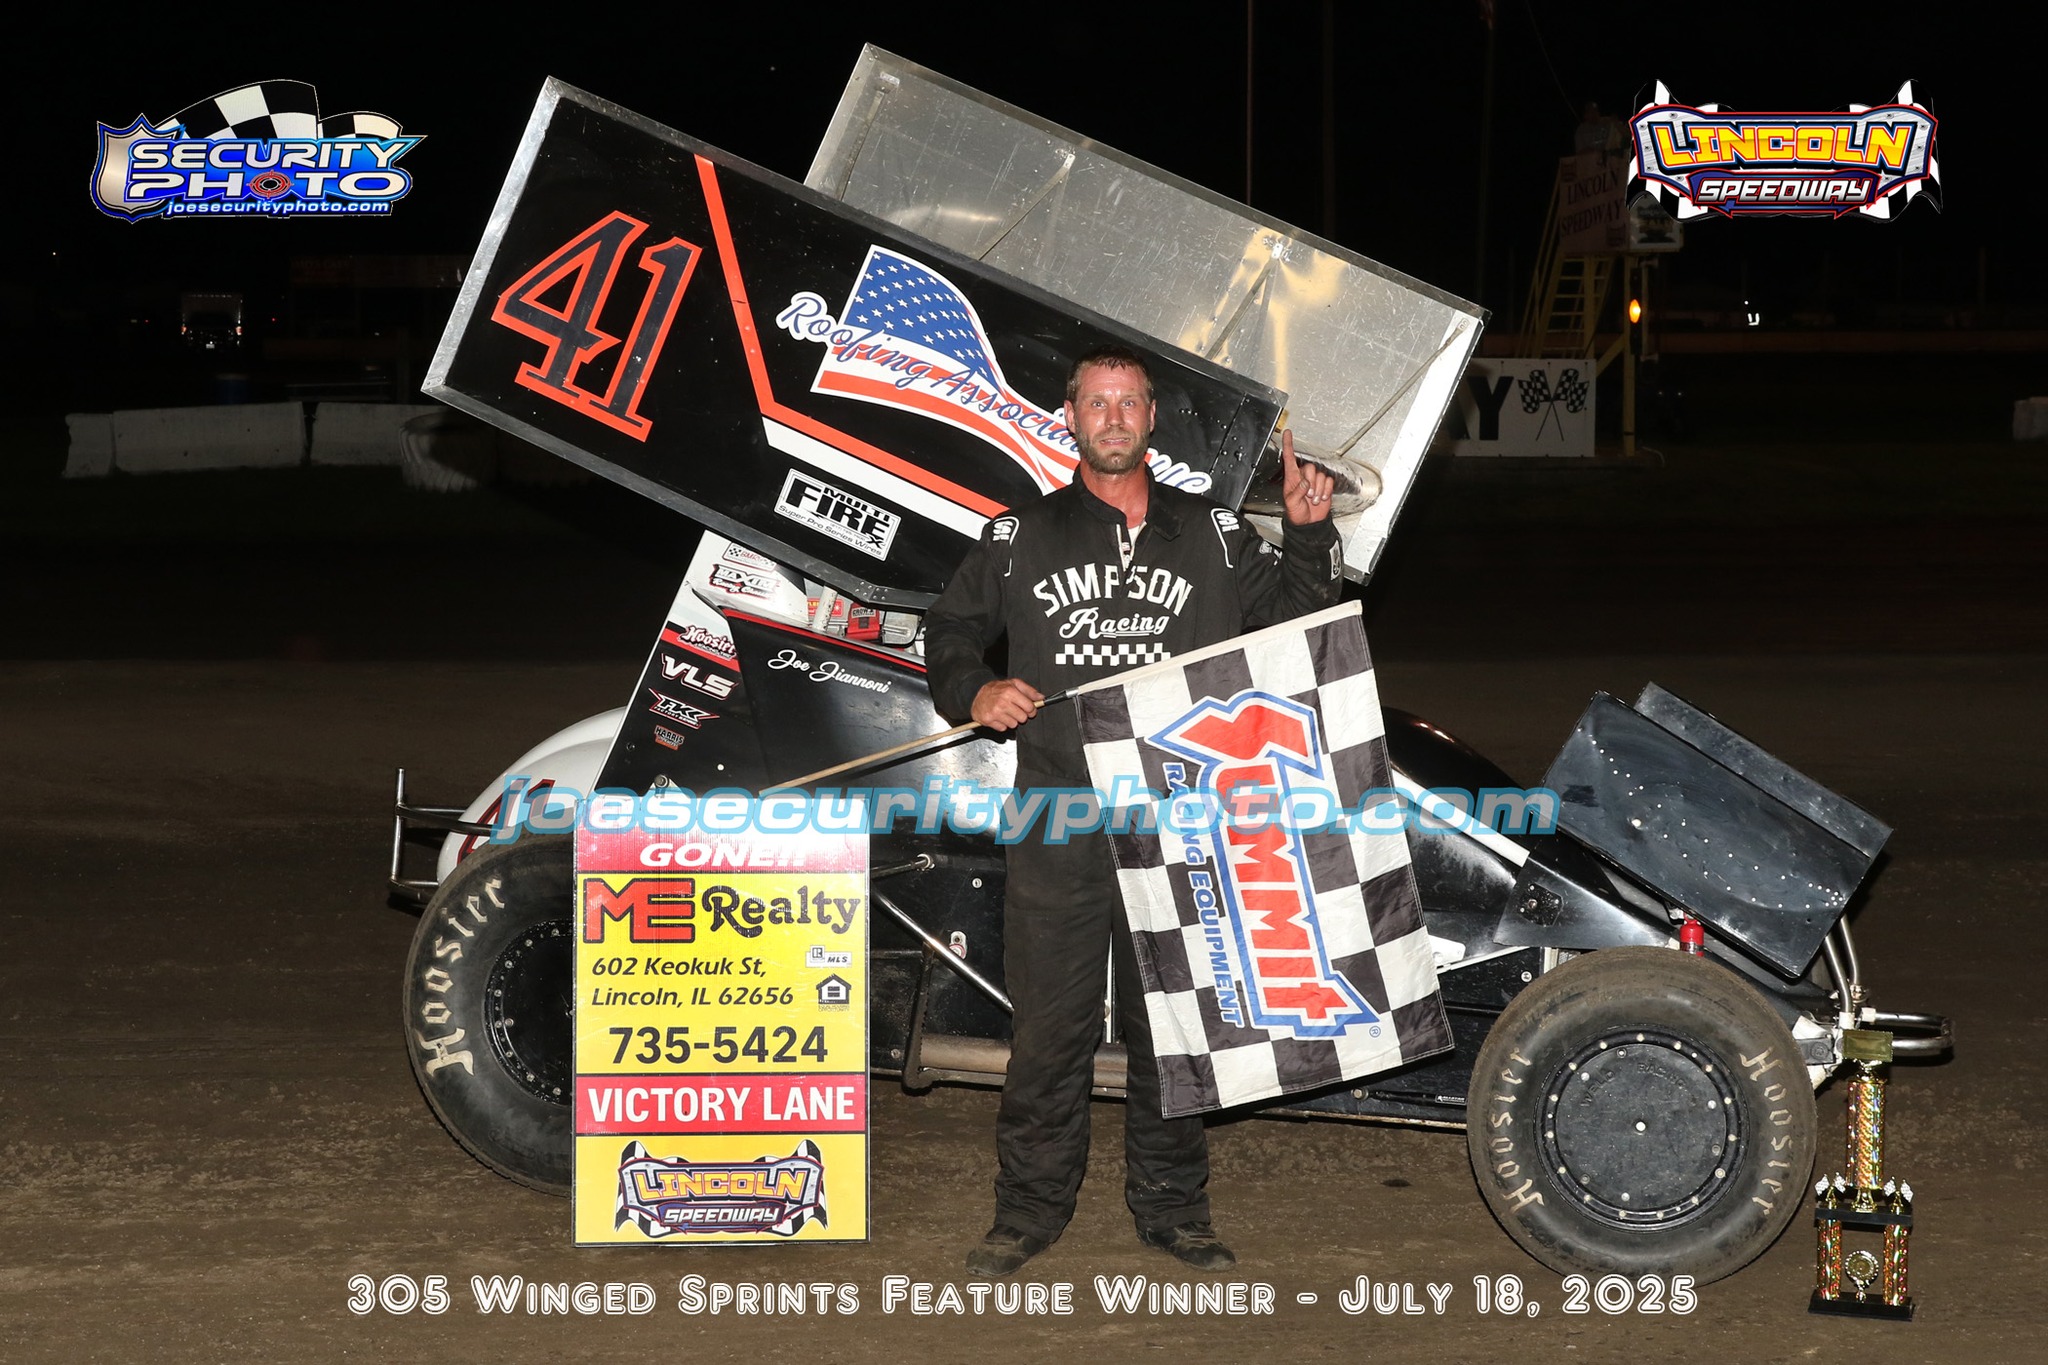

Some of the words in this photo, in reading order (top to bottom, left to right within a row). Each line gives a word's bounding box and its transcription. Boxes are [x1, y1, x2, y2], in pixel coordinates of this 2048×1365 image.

[1567, 168, 1621, 205] LINCOLN
[1560, 199, 1626, 237] SPEEDWAY
[491, 210, 703, 443] 41
[782, 296, 934, 389] Roofing
[785, 477, 890, 541] FIRE
[824, 486, 890, 522] MULTI
[779, 505, 806, 521] Super
[807, 516, 824, 529] Pro
[825, 525, 853, 543] Series
[854, 539, 882, 556] Wires
[714, 565, 775, 592] MAXIM
[1033, 562, 1194, 617] SIMPSON
[681, 626, 736, 654] Hoosier
[1058, 607, 1170, 639] Racing
[664, 655, 735, 698] VLS
[768, 649, 811, 671] Joe
[1178, 704, 1349, 1020] SUMMIT
[583, 878, 695, 943] ME
[701, 885, 862, 938] Realty
[1164, 763, 1206, 864] RACING
[1190, 873, 1243, 1027] EQUIPMENT
[415, 877, 505, 1078] Hoosier
[592, 957, 638, 976] 602
[644, 956, 733, 976] Keokuk
[739, 956, 767, 978] St,
[827, 955, 849, 964] MLS
[592, 987, 683, 1008] Lincoln,
[691, 987, 712, 1006] IL
[719, 986, 794, 1006] 62656
[609, 1026, 828, 1064] 735-5424
[588, 1086, 751, 1123] VICTORY
[763, 1086, 855, 1122] LANE
[1490, 1046, 1545, 1214] Hoosier
[1739, 1046, 1794, 1215] Hoosier
[632, 1169, 808, 1201] LINCOLN
[664, 1207, 780, 1224] SPEEDWAY
